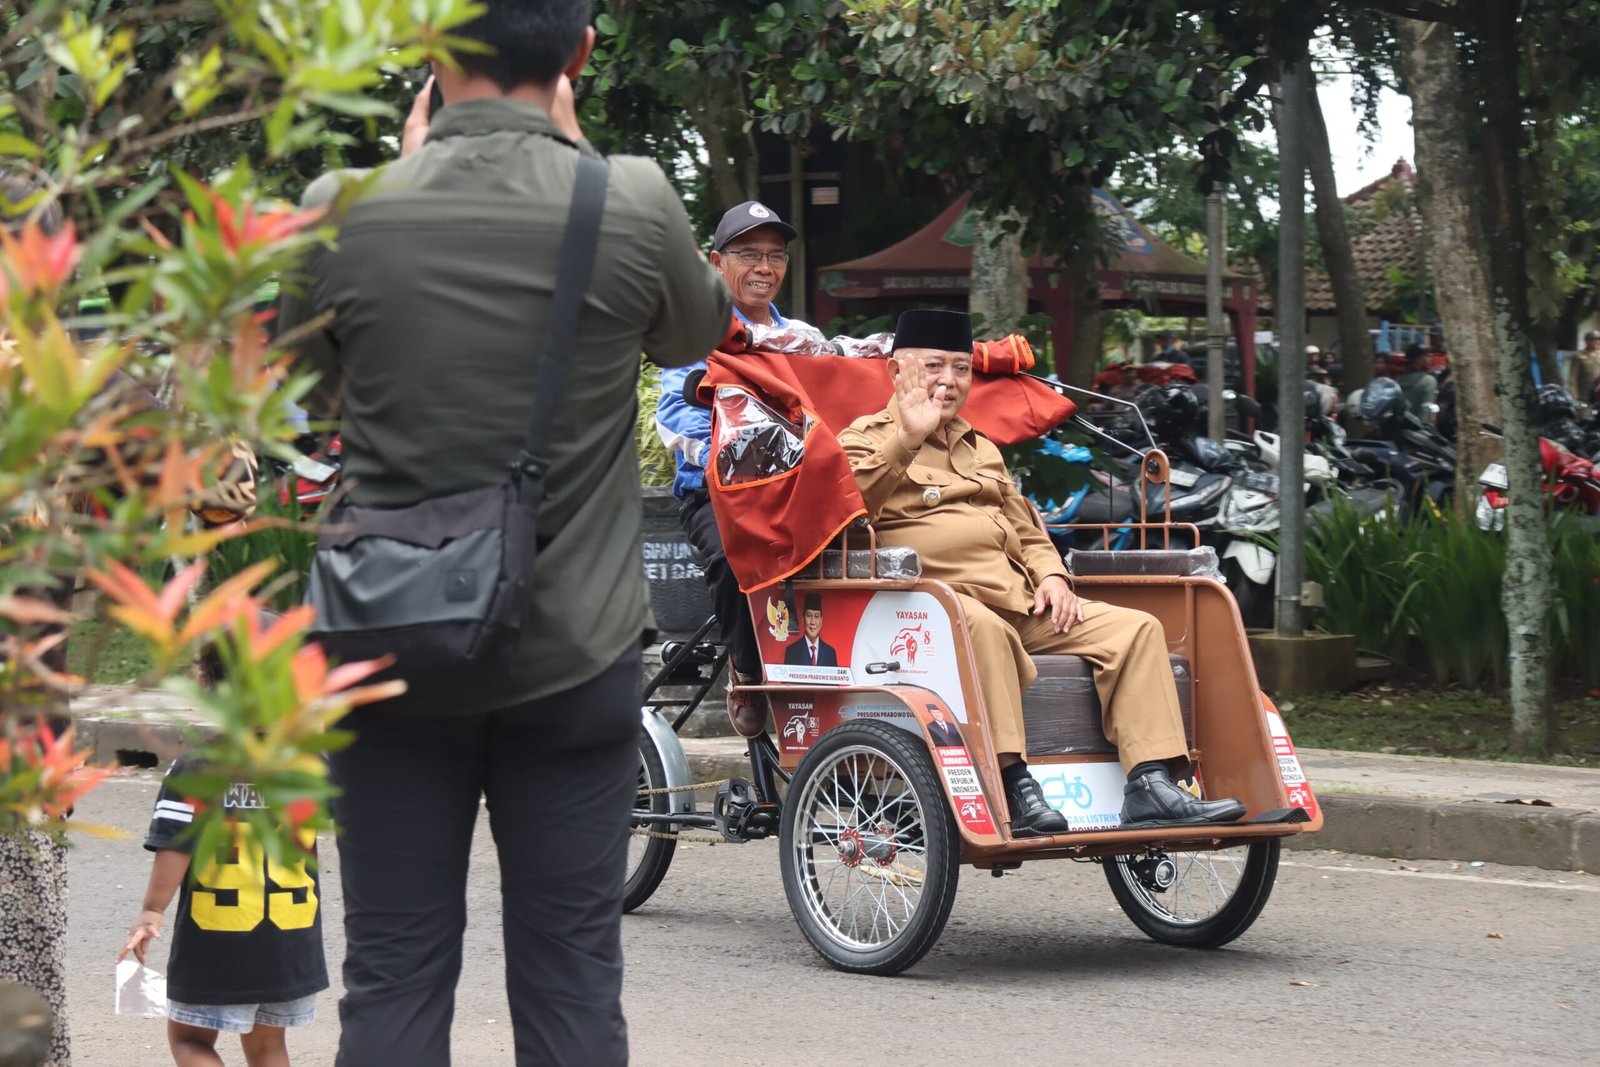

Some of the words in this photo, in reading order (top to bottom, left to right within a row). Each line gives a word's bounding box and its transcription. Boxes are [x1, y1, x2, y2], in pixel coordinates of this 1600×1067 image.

[896, 611, 928, 620] YAYASAN
[947, 768, 972, 776] PRESIDEN
[223, 783, 270, 809] WA
[1067, 815, 1086, 824] CAK
[1086, 813, 1118, 823] LISTRIK
